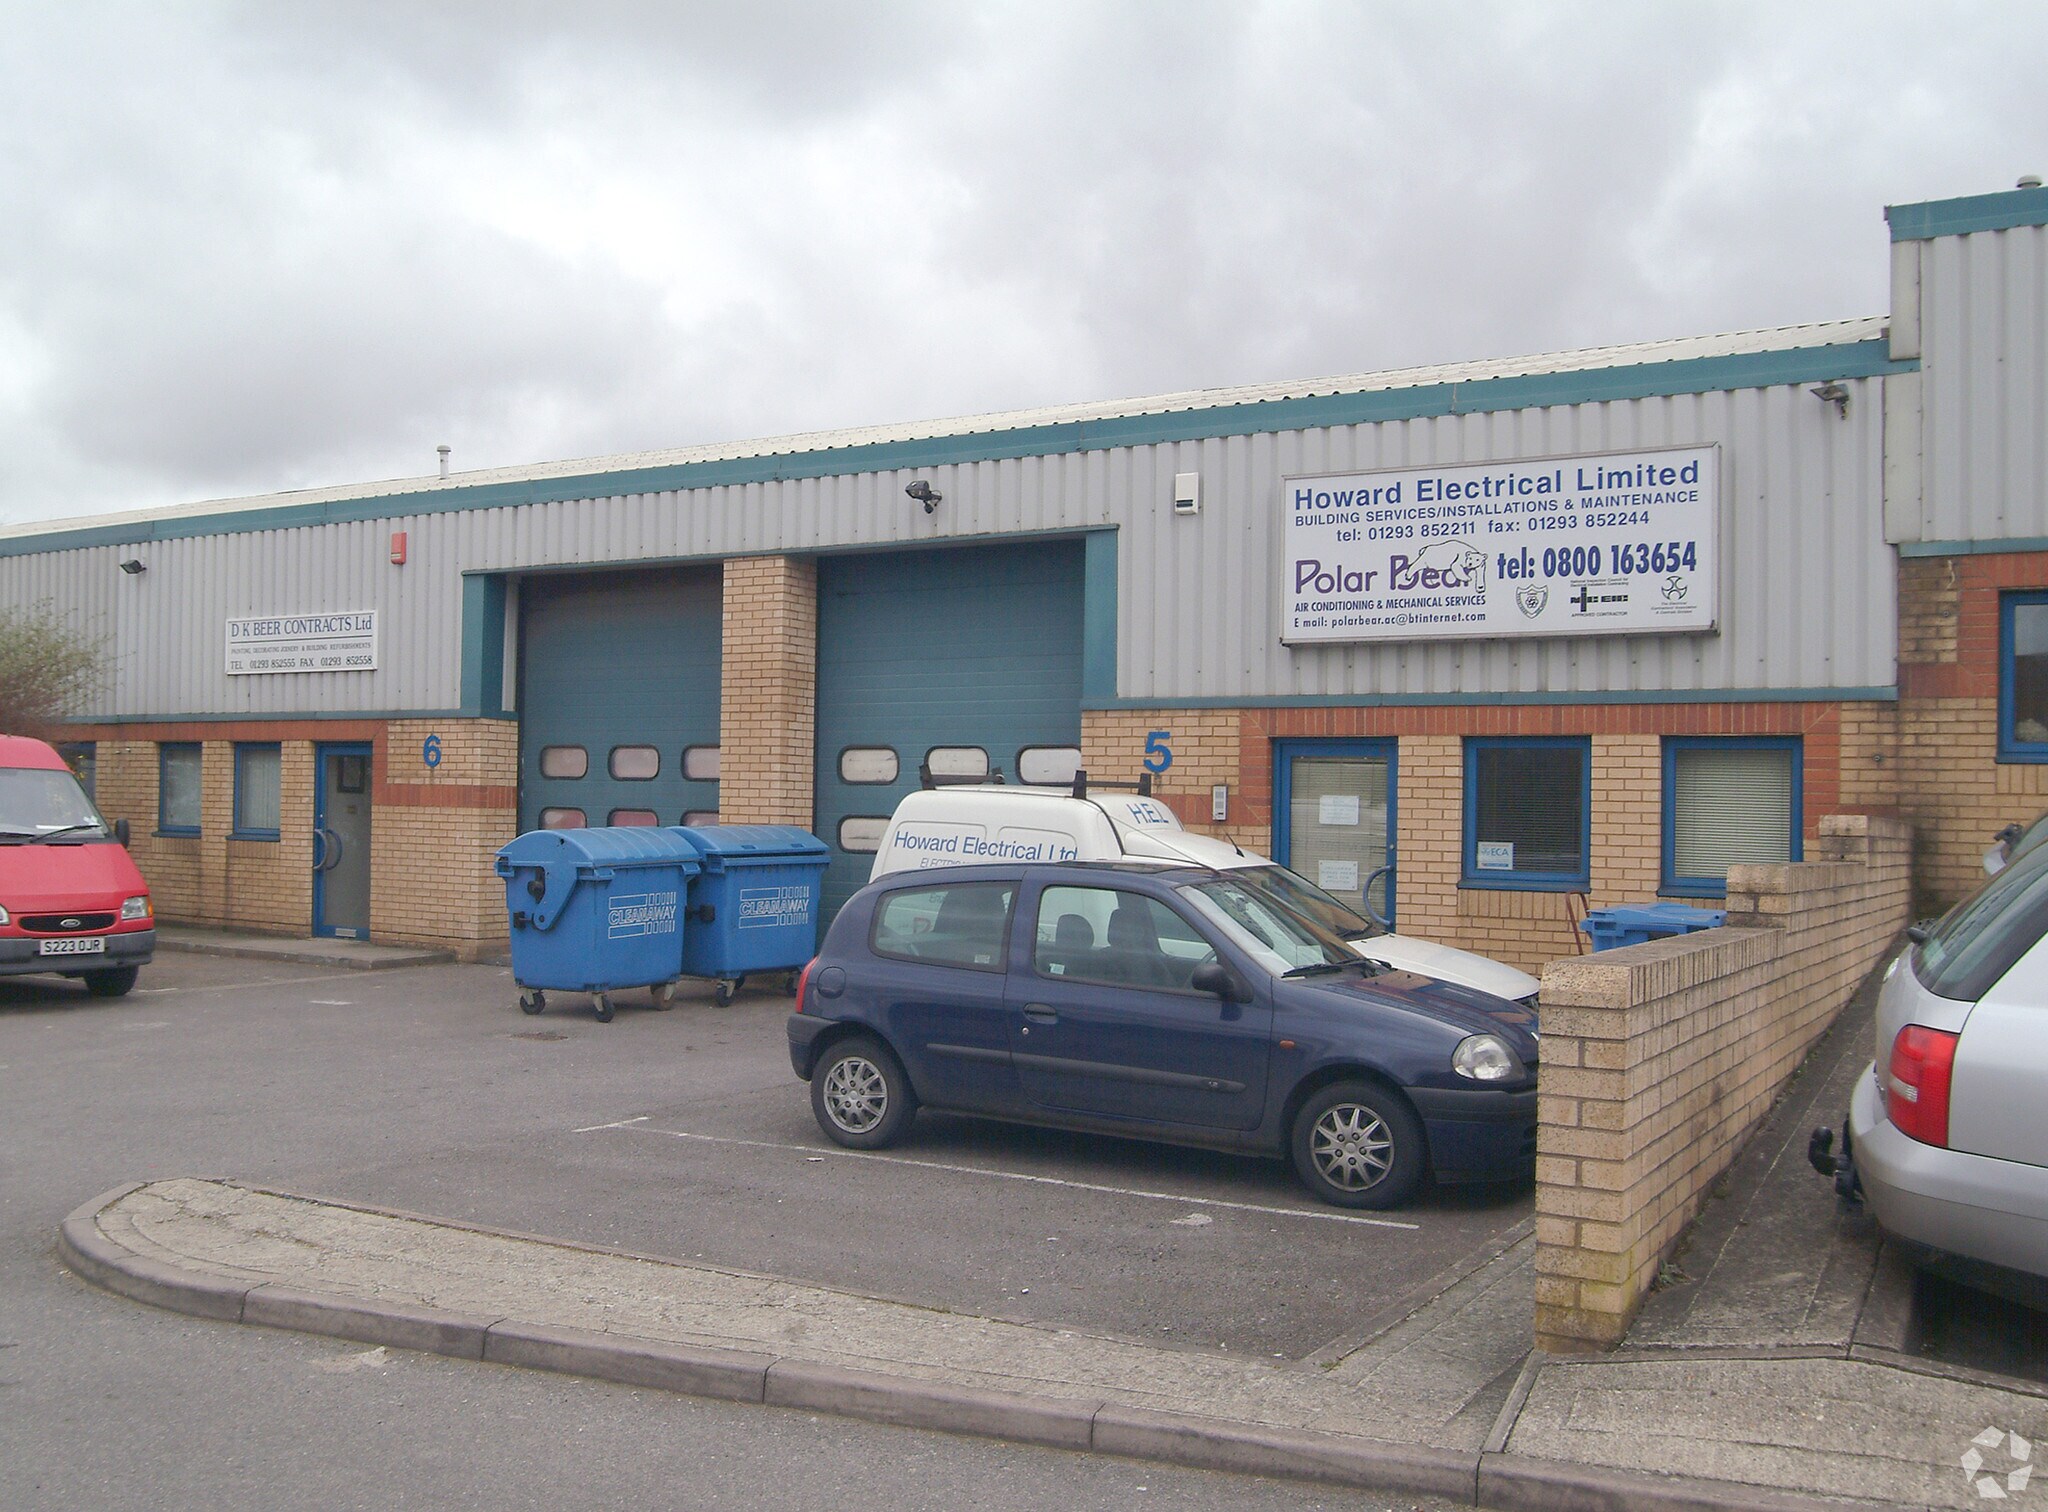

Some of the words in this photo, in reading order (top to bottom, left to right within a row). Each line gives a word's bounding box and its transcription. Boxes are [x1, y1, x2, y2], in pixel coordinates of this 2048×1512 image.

[1295, 482, 1401, 510] Howard
[1417, 470, 1561, 502] Electrical
[1577, 460, 1698, 491] Limited
[1295, 512, 1360, 526] BUILDING
[1366, 499, 1558, 522] SERVICES/INSTALLATIONS
[1564, 499, 1574, 510] &
[1581, 490, 1698, 509] MAINTENANCE
[1337, 529, 1361, 542] tel:
[1368, 526, 1414, 541] 01293
[1421, 522, 1475, 538] 852211
[1488, 519, 1520, 533] fax:
[1528, 515, 1577, 531] 01293
[1585, 511, 1650, 528] 852244
[1497, 547, 1535, 579] tel:
[1543, 545, 1601, 578] 0800
[1611, 541, 1697, 574] 163654
[1295, 560, 1378, 594] Polar
[1390, 555, 1471, 590] Bear
[1295, 602, 1309, 613] AIR
[1311, 599, 1374, 612] CONDITIONING
[1376, 599, 1383, 610] &
[1385, 597, 1443, 609] MECHANICAL
[1445, 594, 1486, 607] SERVICES
[231, 623, 240, 637] D
[243, 622, 250, 636] K
[253, 621, 281, 636] BEER
[284, 616, 352, 635] CONTRACTS
[355, 615, 372, 631] Ltd
[1294, 618, 1299, 628] E
[1303, 616, 1328, 627] mail:
[1331, 612, 1486, 629] polarbear.ac@btinternet.com
[231, 660, 243, 670] TEL
[250, 659, 269, 669] 01293
[300, 657, 314, 667] FAX
[321, 656, 342, 666] 01293
[423, 735, 442, 768] 6
[1143, 731, 1173, 773] 5
[894, 831, 958, 853] Howard
[962, 836, 1043, 861] Electrical
[1491, 847, 1509, 857] ECA
[608, 905, 677, 925] CLEANAWAY
[739, 899, 809, 916] CLEANAWAY
[44, 941, 75, 953] S223
